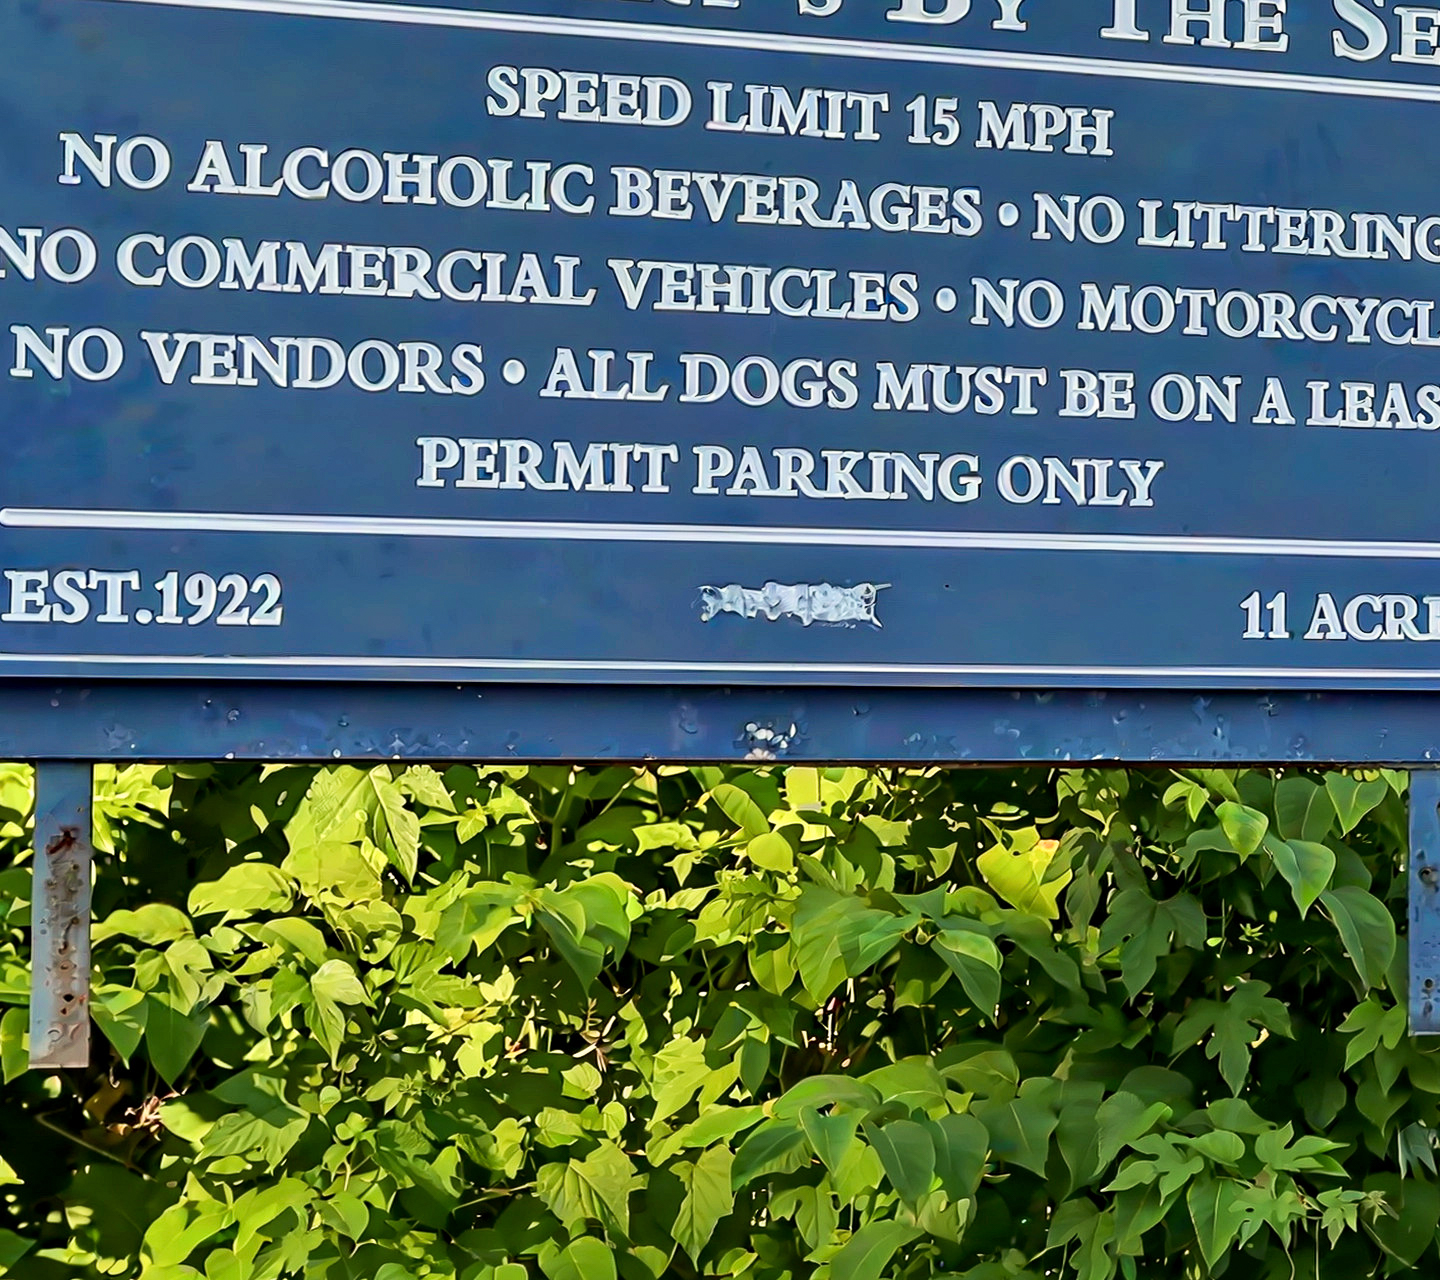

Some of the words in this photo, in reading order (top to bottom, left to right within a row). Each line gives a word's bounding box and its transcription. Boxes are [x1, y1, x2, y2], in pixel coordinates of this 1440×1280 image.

[486, 65, 692, 128] SPEED
[706, 82, 889, 143] LIMIT
[906, 95, 959, 146] 15
[975, 100, 1116, 157] MPH
[58, 131, 172, 191] NO
[187, 139, 597, 216] ALCOHOLIC
[608, 164, 983, 236] BEVERAGES
[1031, 194, 1125, 243] NO
[115, 234, 596, 306] COMMERCIAL
[608, 257, 919, 322] VEHICLES
[971, 276, 1065, 328] NO
[9, 324, 124, 382] NO
[141, 330, 484, 395] VENDORS
[539, 346, 668, 403] ALL
[679, 354, 859, 410] DOGS
[872, 360, 1047, 416] MUST
[1058, 368, 1137, 422] BE
[1150, 373, 1240, 424] ON
[1252, 381, 1296, 426] A
[416, 437, 679, 493] PERMIT
[691, 446, 982, 503] PARKING
[995, 454, 1165, 508] ONLY
[1239, 591, 1290, 641] 11
